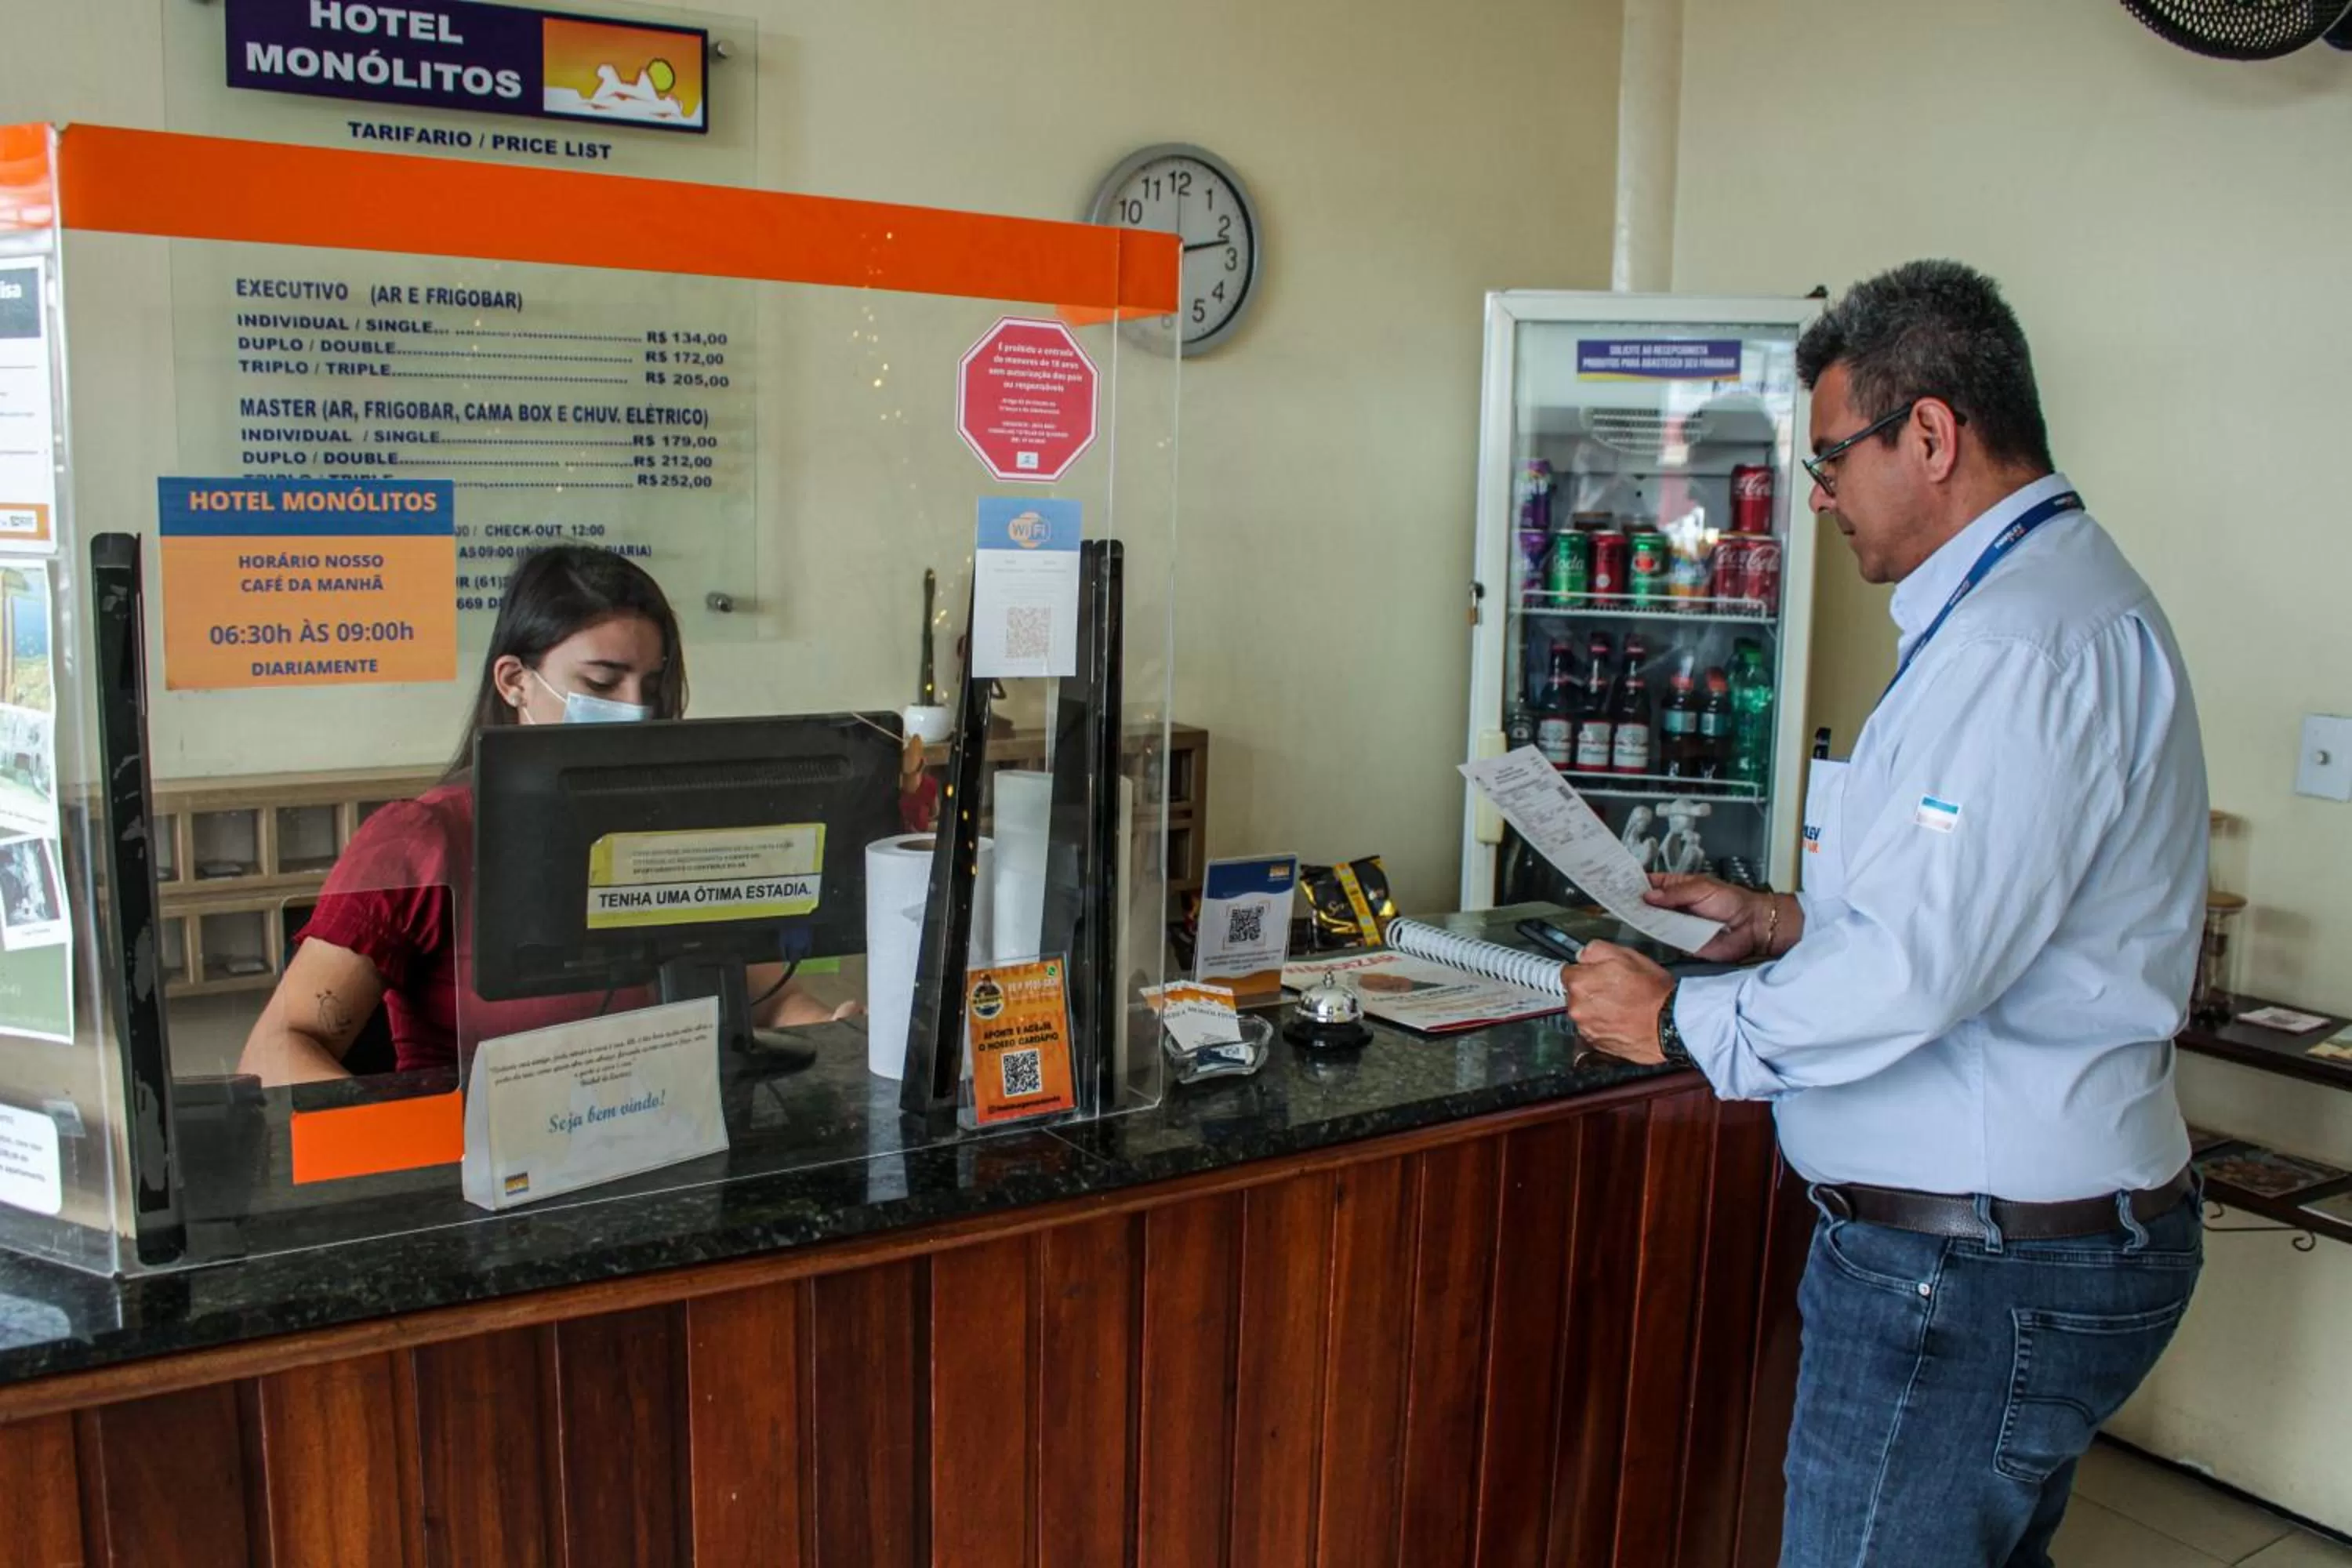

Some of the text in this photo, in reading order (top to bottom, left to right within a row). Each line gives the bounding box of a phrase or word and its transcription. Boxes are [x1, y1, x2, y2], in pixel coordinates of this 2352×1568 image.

[310, 0, 463, 44] HOTEL
[245, 42, 522, 99] MONÓLITOS
[348, 122, 612, 160] TARIFARIO / PRICE LIST
[1142, 176, 1161, 201] 11
[1167, 171, 1192, 197] 12
[1118, 198, 1142, 224] 10
[1204, 188, 1214, 212] 1
[1218, 215, 1231, 238] 2
[1225, 247, 1238, 271] 3
[236, 278, 522, 311] EXECUTIVO (AR E FRIGOBAR)
[1211, 280, 1225, 303] 4
[237, 314, 350, 330] INDIVIDUAL
[1192, 298, 1206, 323] 5
[238, 336, 303, 351] DUPLO
[320, 339, 396, 354] DOUBLE
[647, 331, 728, 347] R$ 134,00
[238, 360, 309, 375] TRIPLO
[325, 361, 391, 376] TRIPLE
[645, 350, 724, 365] R$ 172,00
[645, 372, 729, 388] R$ 205,00
[240, 398, 709, 430] MASTER (AR, FRIGOBAR, CAMA BOX E CHUV. ELÉTRICO)
[241, 428, 352, 443] INDIVIDUAL
[633, 435, 717, 448] R$ 179,00
[242, 452, 307, 465] DUPLO
[323, 452, 398, 466] DOUBLE
[633, 455, 712, 469] R$ 212,00
[189, 487, 437, 511] HOTEL MONÓLITOS
[485, 524, 562, 537] CHECK-OUT
[571, 524, 605, 537] 12:00
[238, 551, 383, 568] HORÁRIO NOSSO
[241, 574, 383, 592] CAFÉ DA MANHÃ
[209, 619, 415, 645] 06:30h ÀS 09:00h
[252, 659, 378, 677] DIARIAMENTE
[598, 892, 652, 908] TENHA
[656, 889, 691, 905] UMA
[746, 882, 811, 899] ESTADIA.
[548, 1088, 666, 1134] Seja bem vindo!
